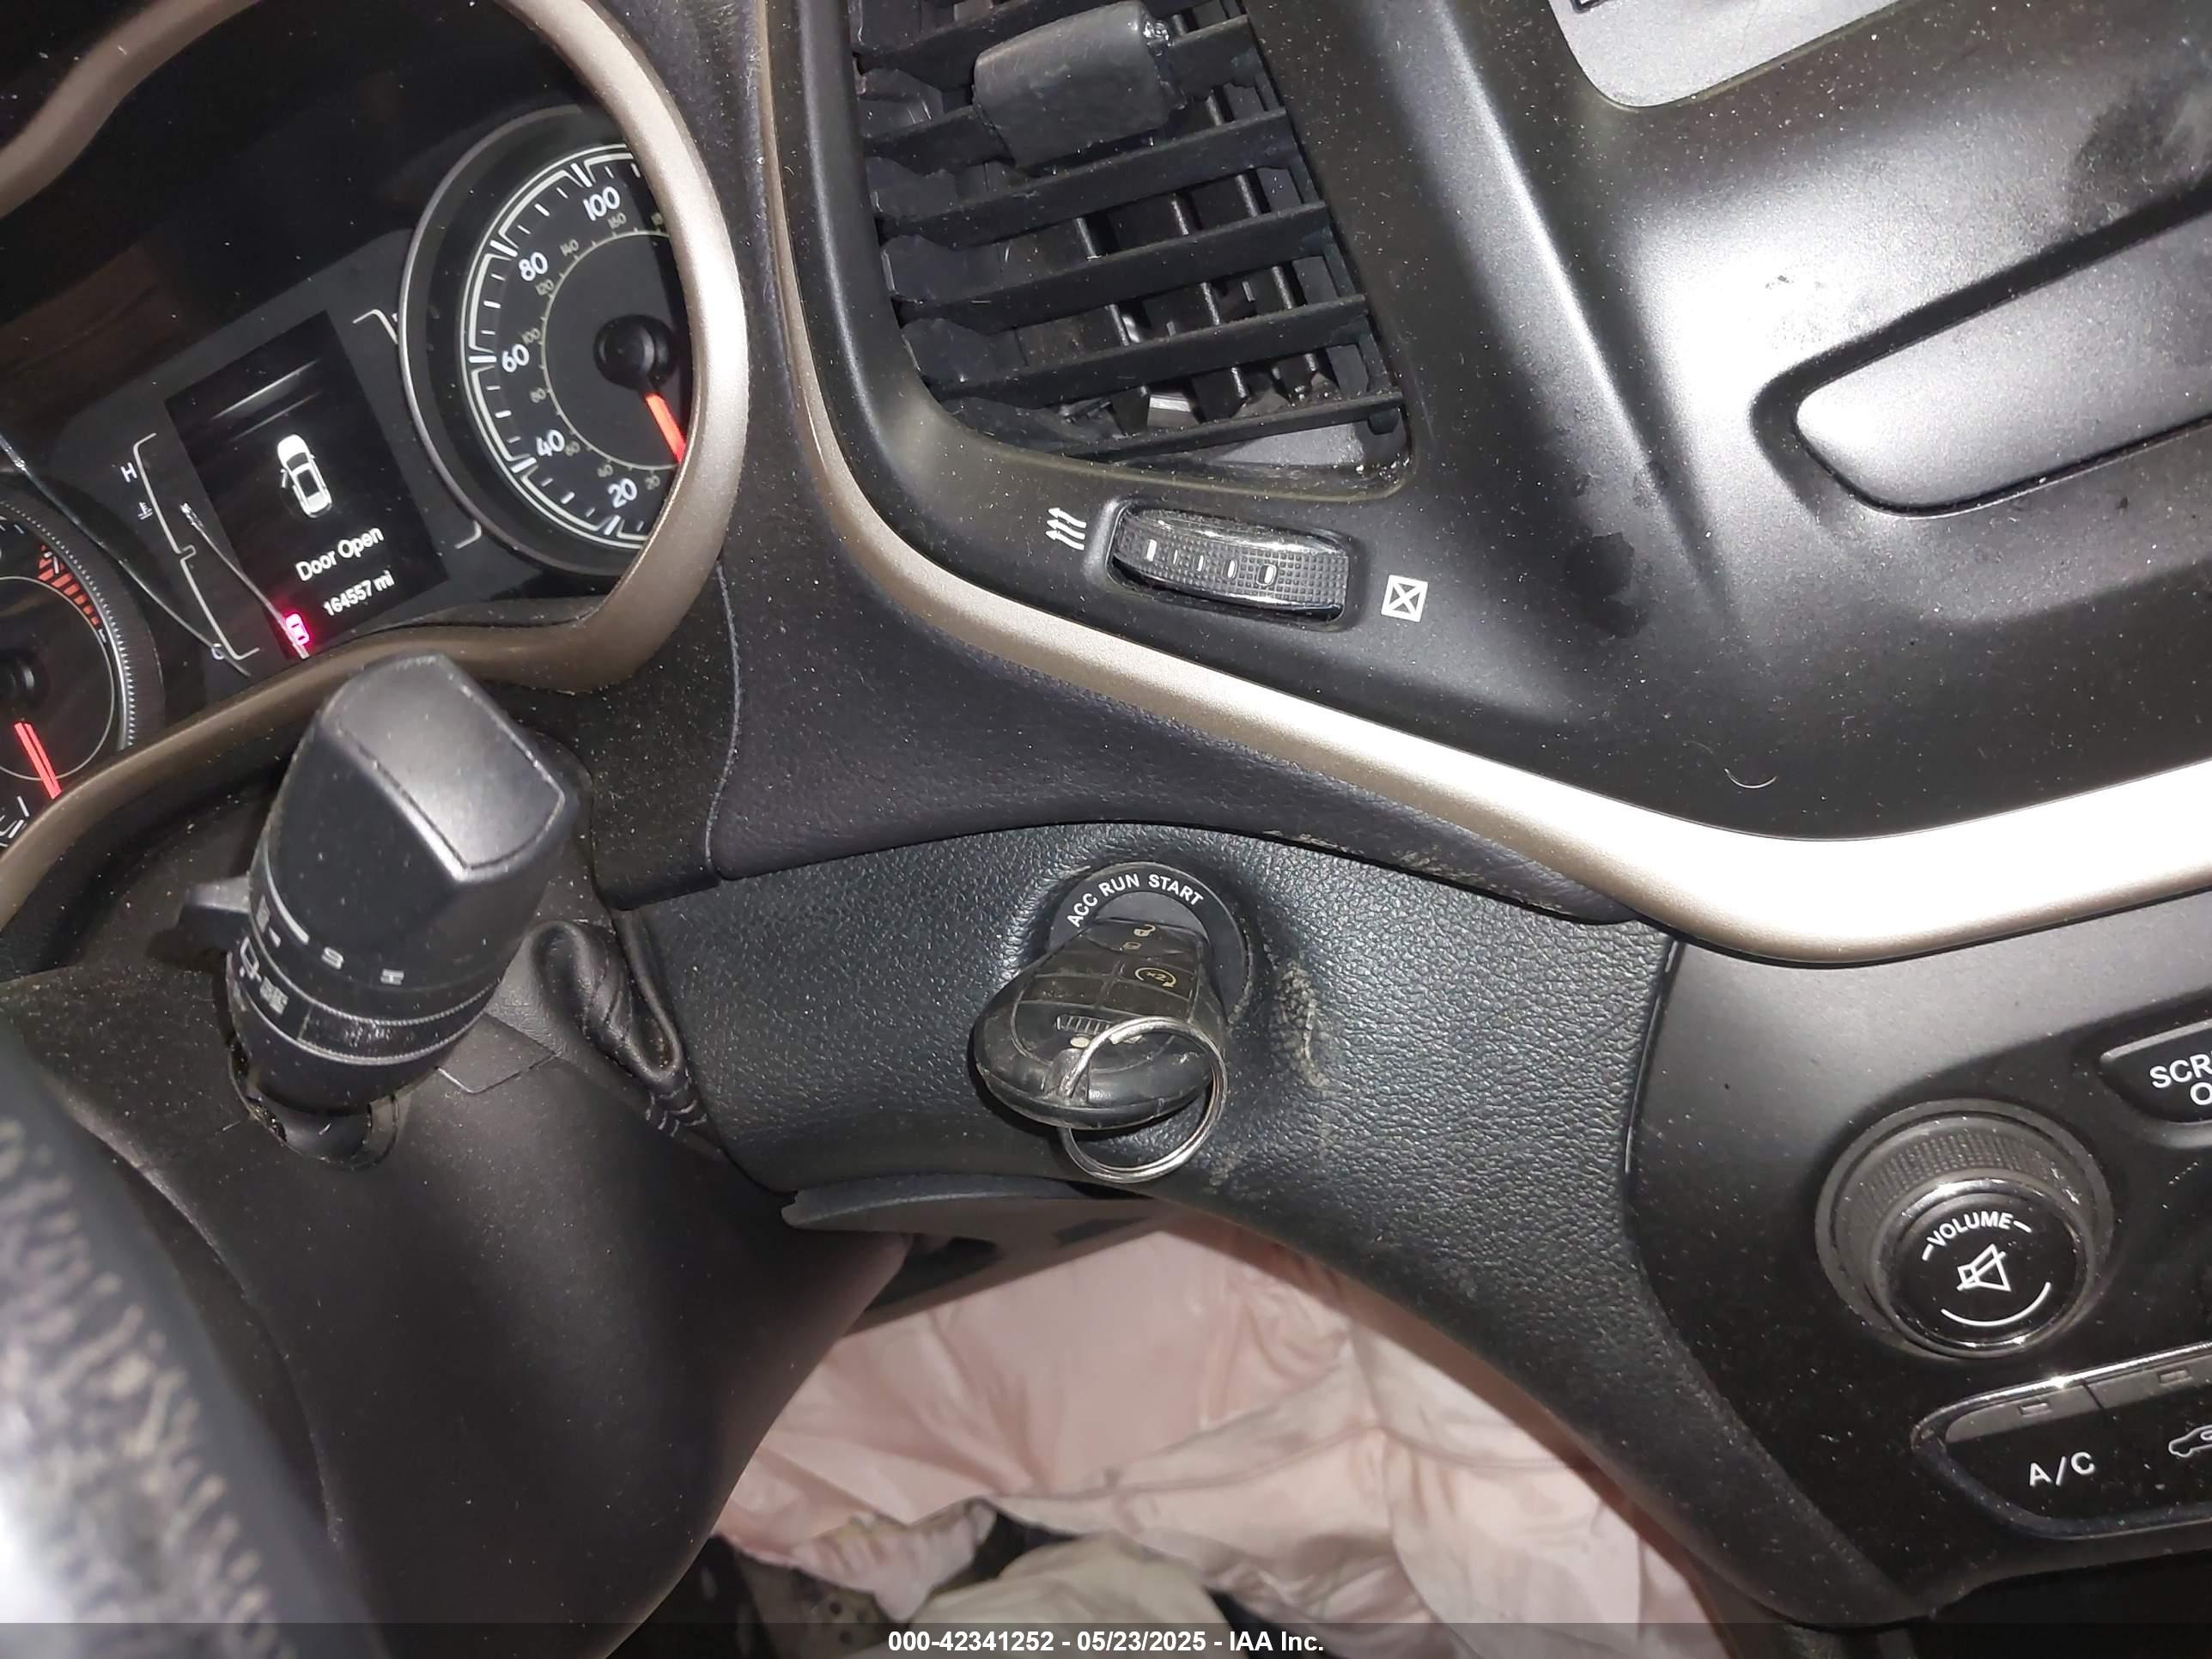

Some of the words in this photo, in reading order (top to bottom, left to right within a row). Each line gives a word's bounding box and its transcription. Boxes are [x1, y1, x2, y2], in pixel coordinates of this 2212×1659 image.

[582, 186, 621, 222] 100
[607, 212, 627, 229] 160
[559, 239, 580, 257] 140
[518, 252, 548, 282] 80
[535, 279, 555, 296] 120
[521, 328, 541, 345] 100
[501, 343, 530, 373] 60
[529, 387, 547, 404] 80
[536, 429, 565, 457] 40
[120, 462, 138, 483] H
[646, 475, 661, 490] 20
[608, 477, 638, 508] 20
[295, 550, 337, 581] Door
[337, 527, 385, 558] Open
[322, 580, 373, 617] 164557
[373, 569, 395, 592] mi
[1067, 893, 1098, 927] ACC
[1098, 873, 1140, 897] RUN
[1148, 874, 1204, 906] START
[2149, 1051, 2212, 1089] SCR
[1926, 1211, 2014, 1248] VOLUME
[2029, 1451, 2096, 1487] A/C
